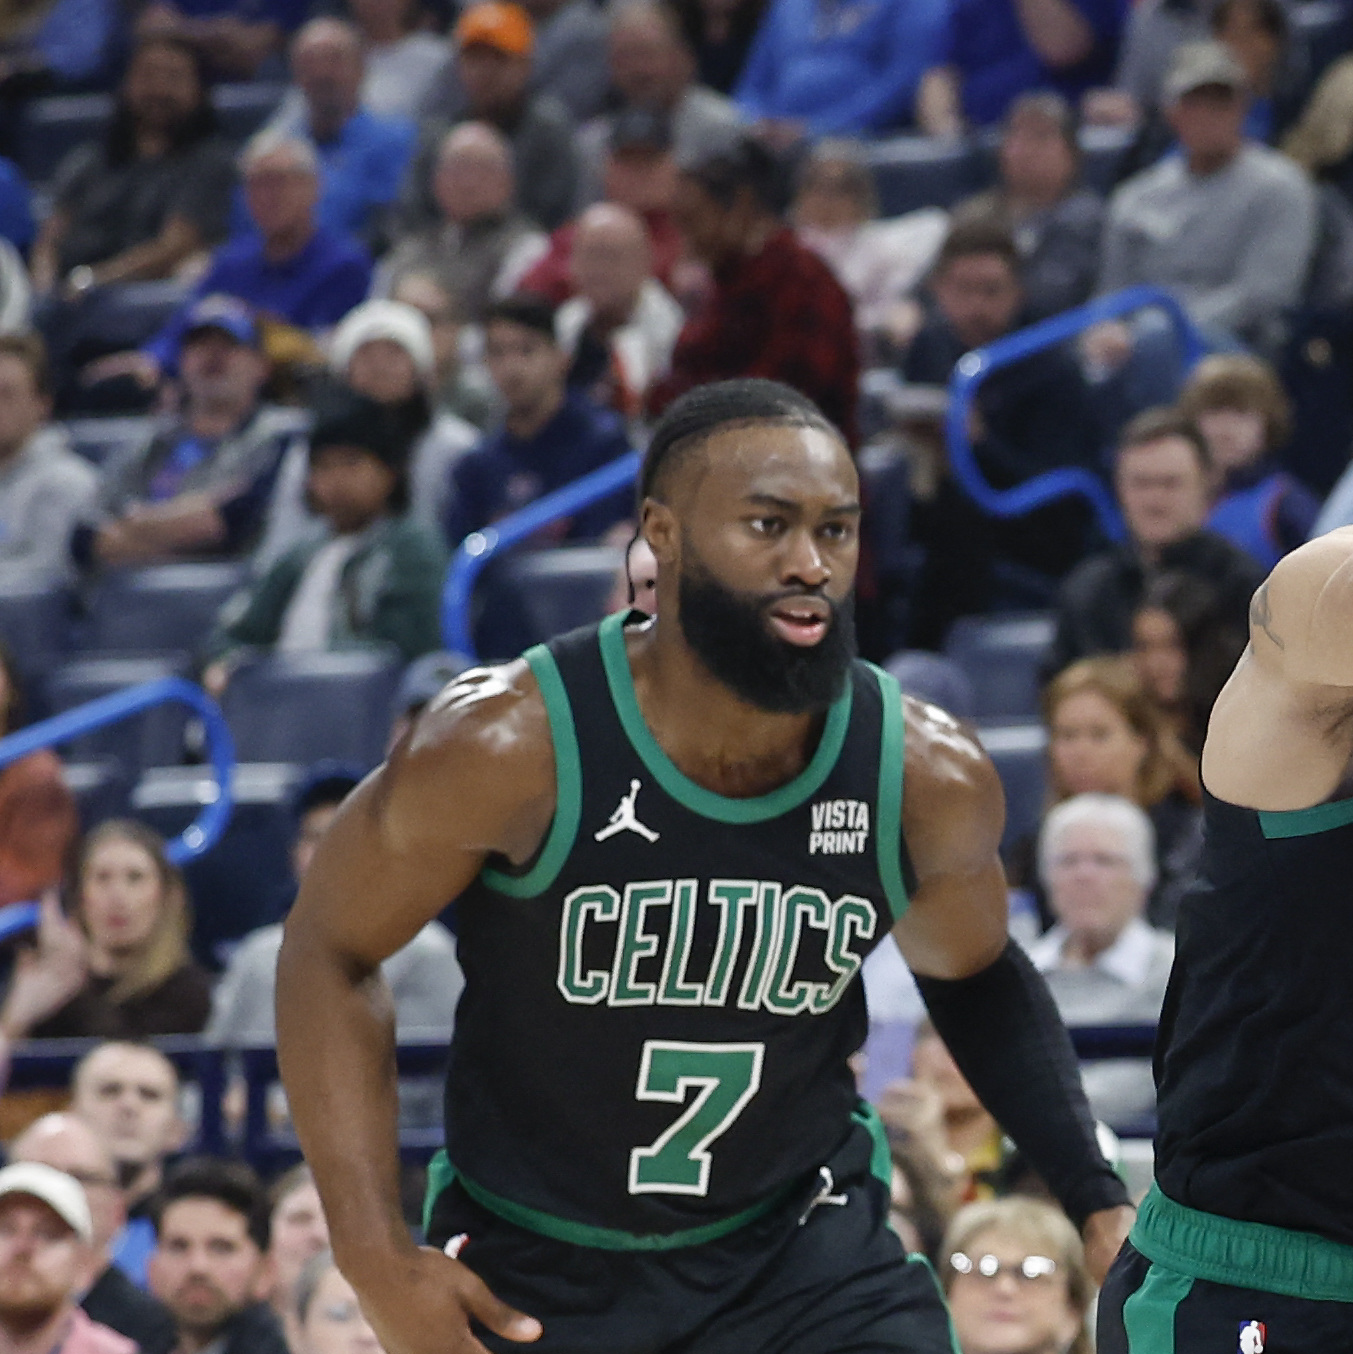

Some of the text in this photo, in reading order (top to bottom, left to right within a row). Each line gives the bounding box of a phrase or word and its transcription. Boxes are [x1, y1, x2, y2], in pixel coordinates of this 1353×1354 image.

[809, 830, 869, 855] PRINT
[810, 800, 870, 831] VISTA
[557, 878, 877, 1015] CELTICS
[628, 1039, 765, 1197] 7
